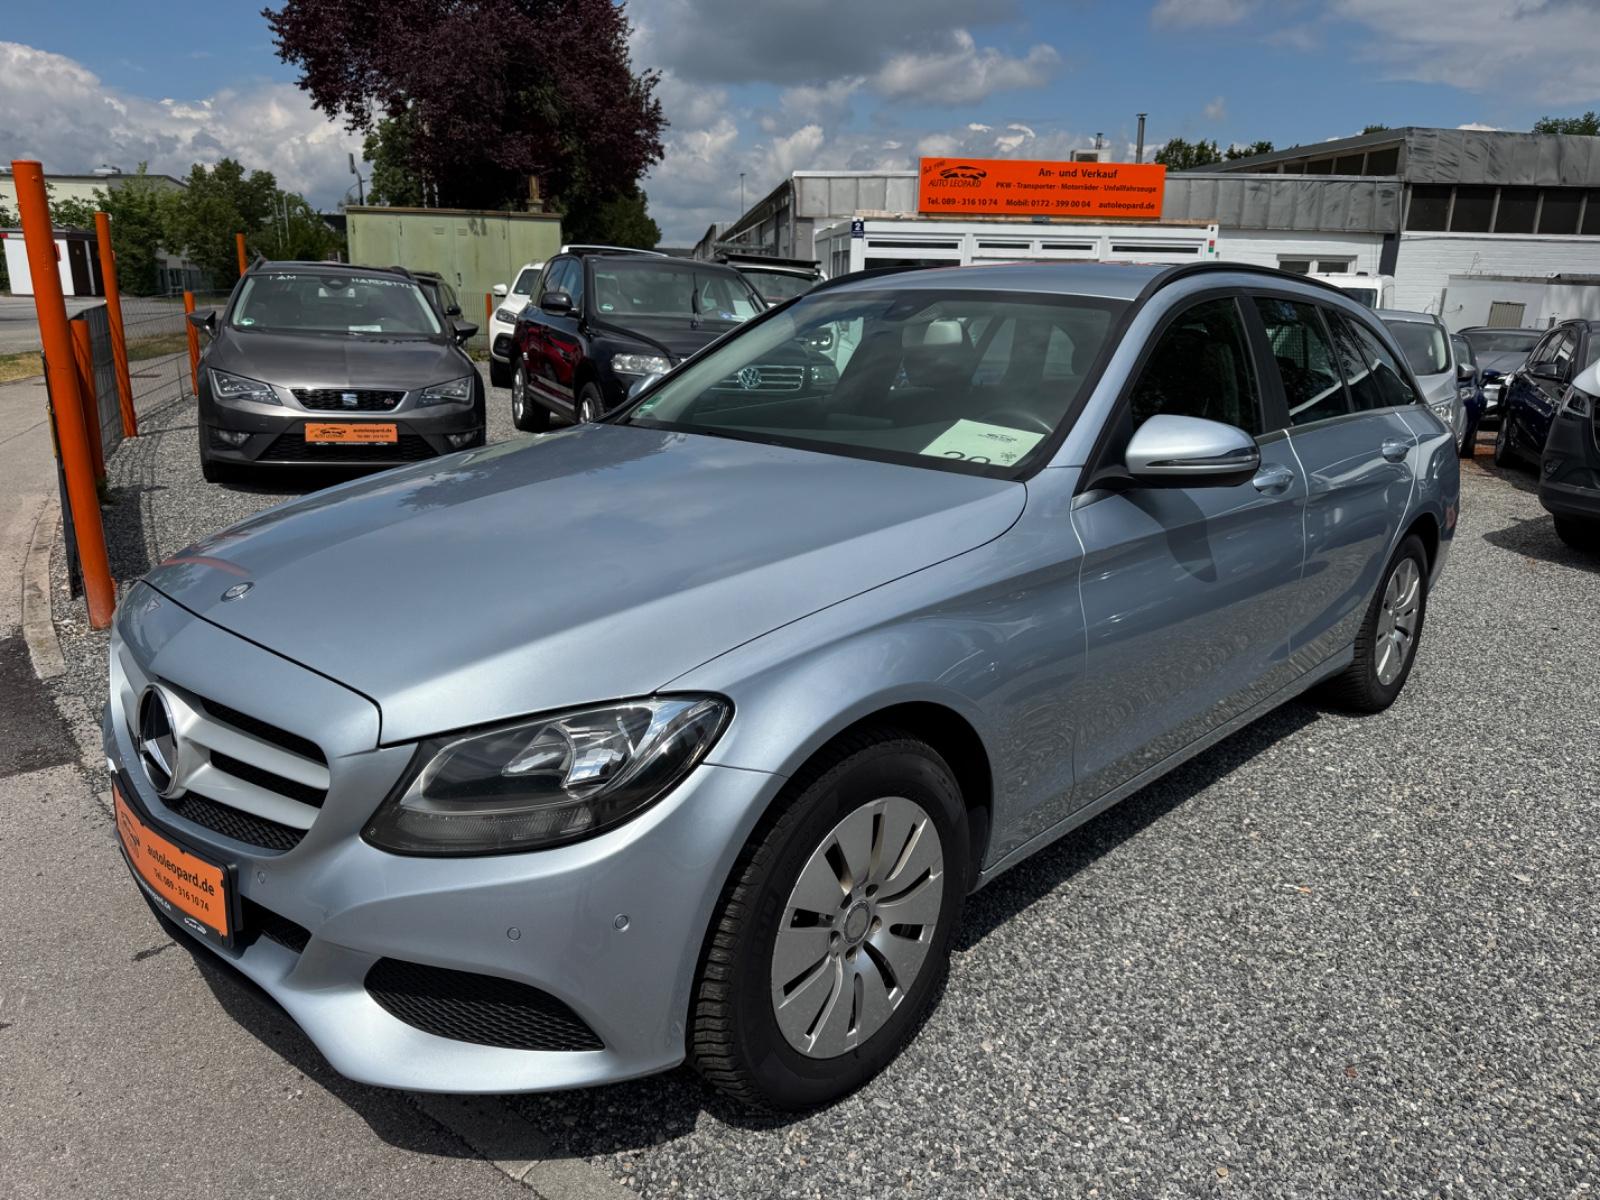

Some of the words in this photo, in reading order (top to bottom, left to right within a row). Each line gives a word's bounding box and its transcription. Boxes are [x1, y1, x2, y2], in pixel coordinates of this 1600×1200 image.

[1039, 168, 1055, 177] An-
[1059, 169, 1077, 177] und
[1081, 169, 1118, 178] Verkauf
[928, 180, 949, 188] AUTO
[950, 180, 982, 188] LEOPARD
[1018, 182, 1056, 191] Transporter
[1061, 183, 1099, 191] Motorräder
[1104, 184, 1156, 193] Unfallfahrzeuge
[928, 197, 940, 205] Tel.
[962, 198, 976, 206] 316
[979, 198, 987, 206] 10
[989, 198, 998, 206] 74
[1006, 199, 1028, 207] Mobil:
[1031, 199, 1050, 208] 0172
[1056, 199, 1070, 208] 399
[1071, 200, 1080, 208] 00
[1081, 200, 1091, 208] 04
[1098, 201, 1155, 210] autoleopard.de
[855, 222, 861, 231] 2
[147, 845, 215, 896] autoleopard.de
[164, 876, 175, 890] 089
[179, 887, 190, 900] 316
[191, 894, 200, 906] 10
[201, 899, 210, 912] 74
